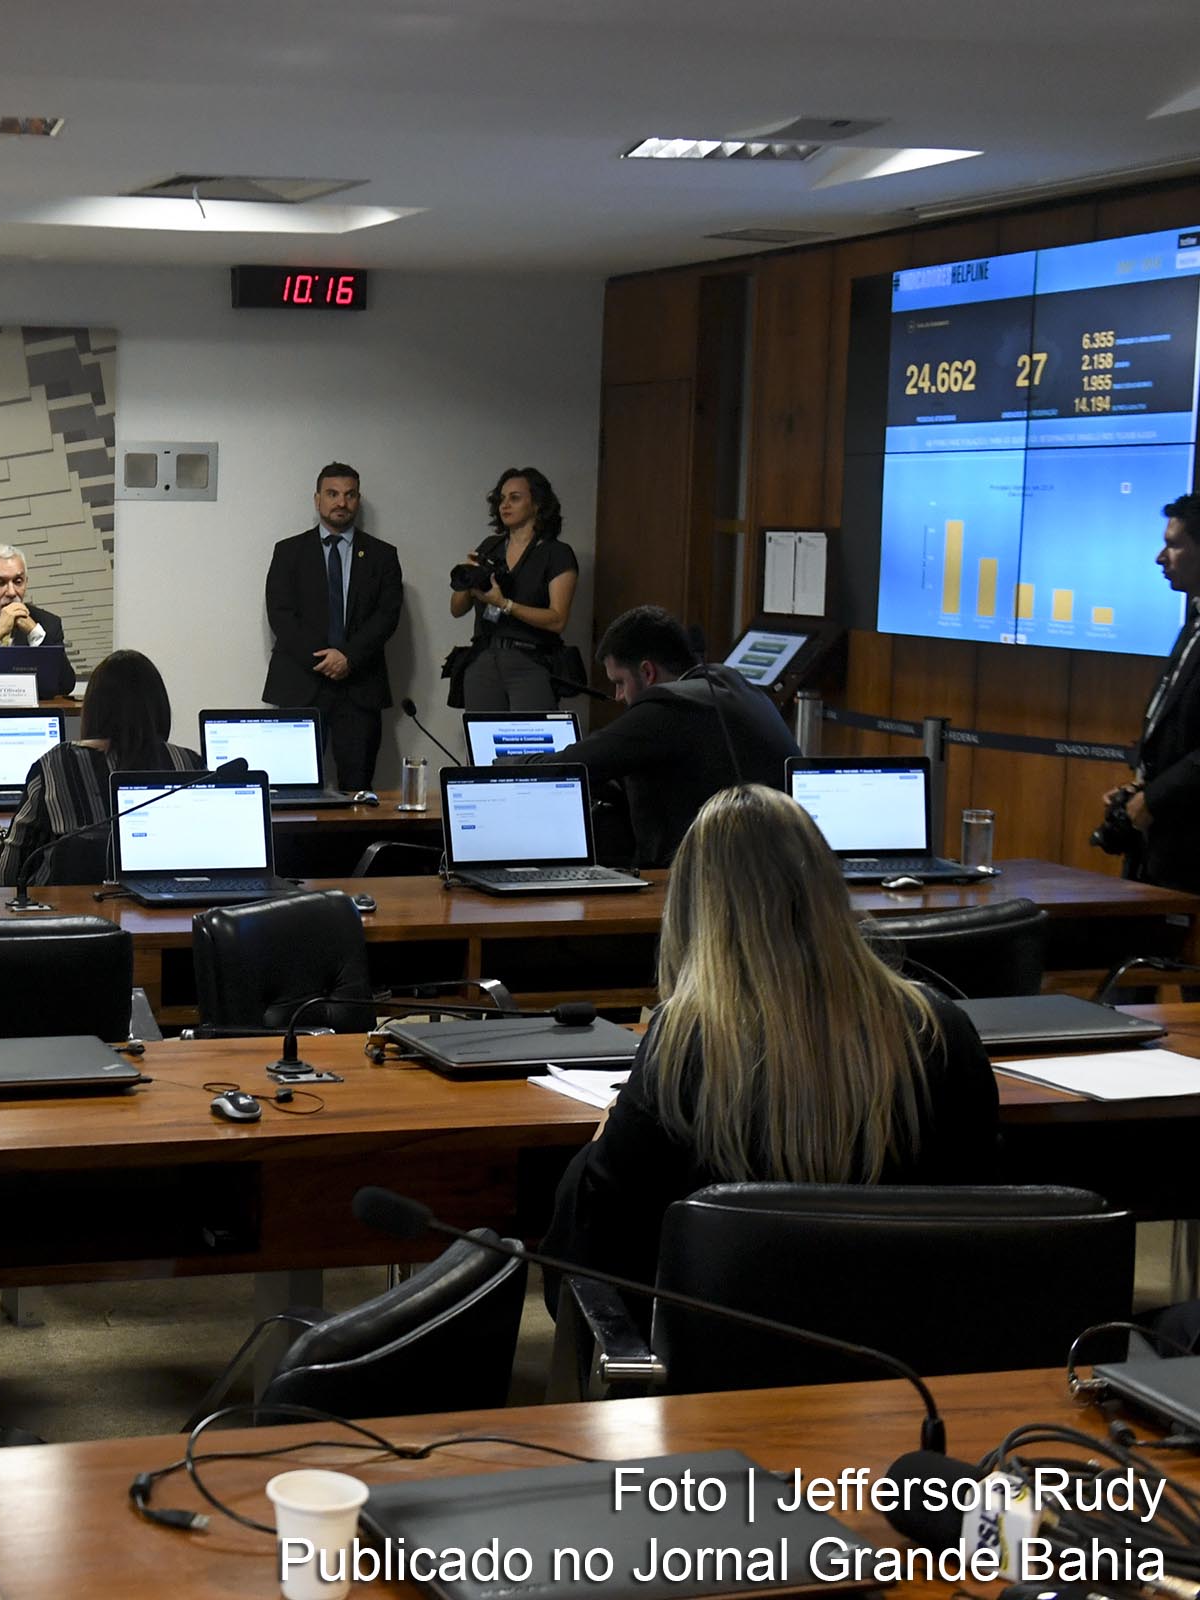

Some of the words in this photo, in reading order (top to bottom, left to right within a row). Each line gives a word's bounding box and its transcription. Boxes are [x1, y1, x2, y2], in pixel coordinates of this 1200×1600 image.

[282, 274, 355, 305] 10:16
[1082, 331, 1115, 350] 6.355
[1015, 352, 1048, 387] 27
[1081, 353, 1114, 371] 2.158
[905, 359, 977, 395] 24.662
[1082, 374, 1113, 392] 1.955
[1074, 396, 1111, 413] 14.194
